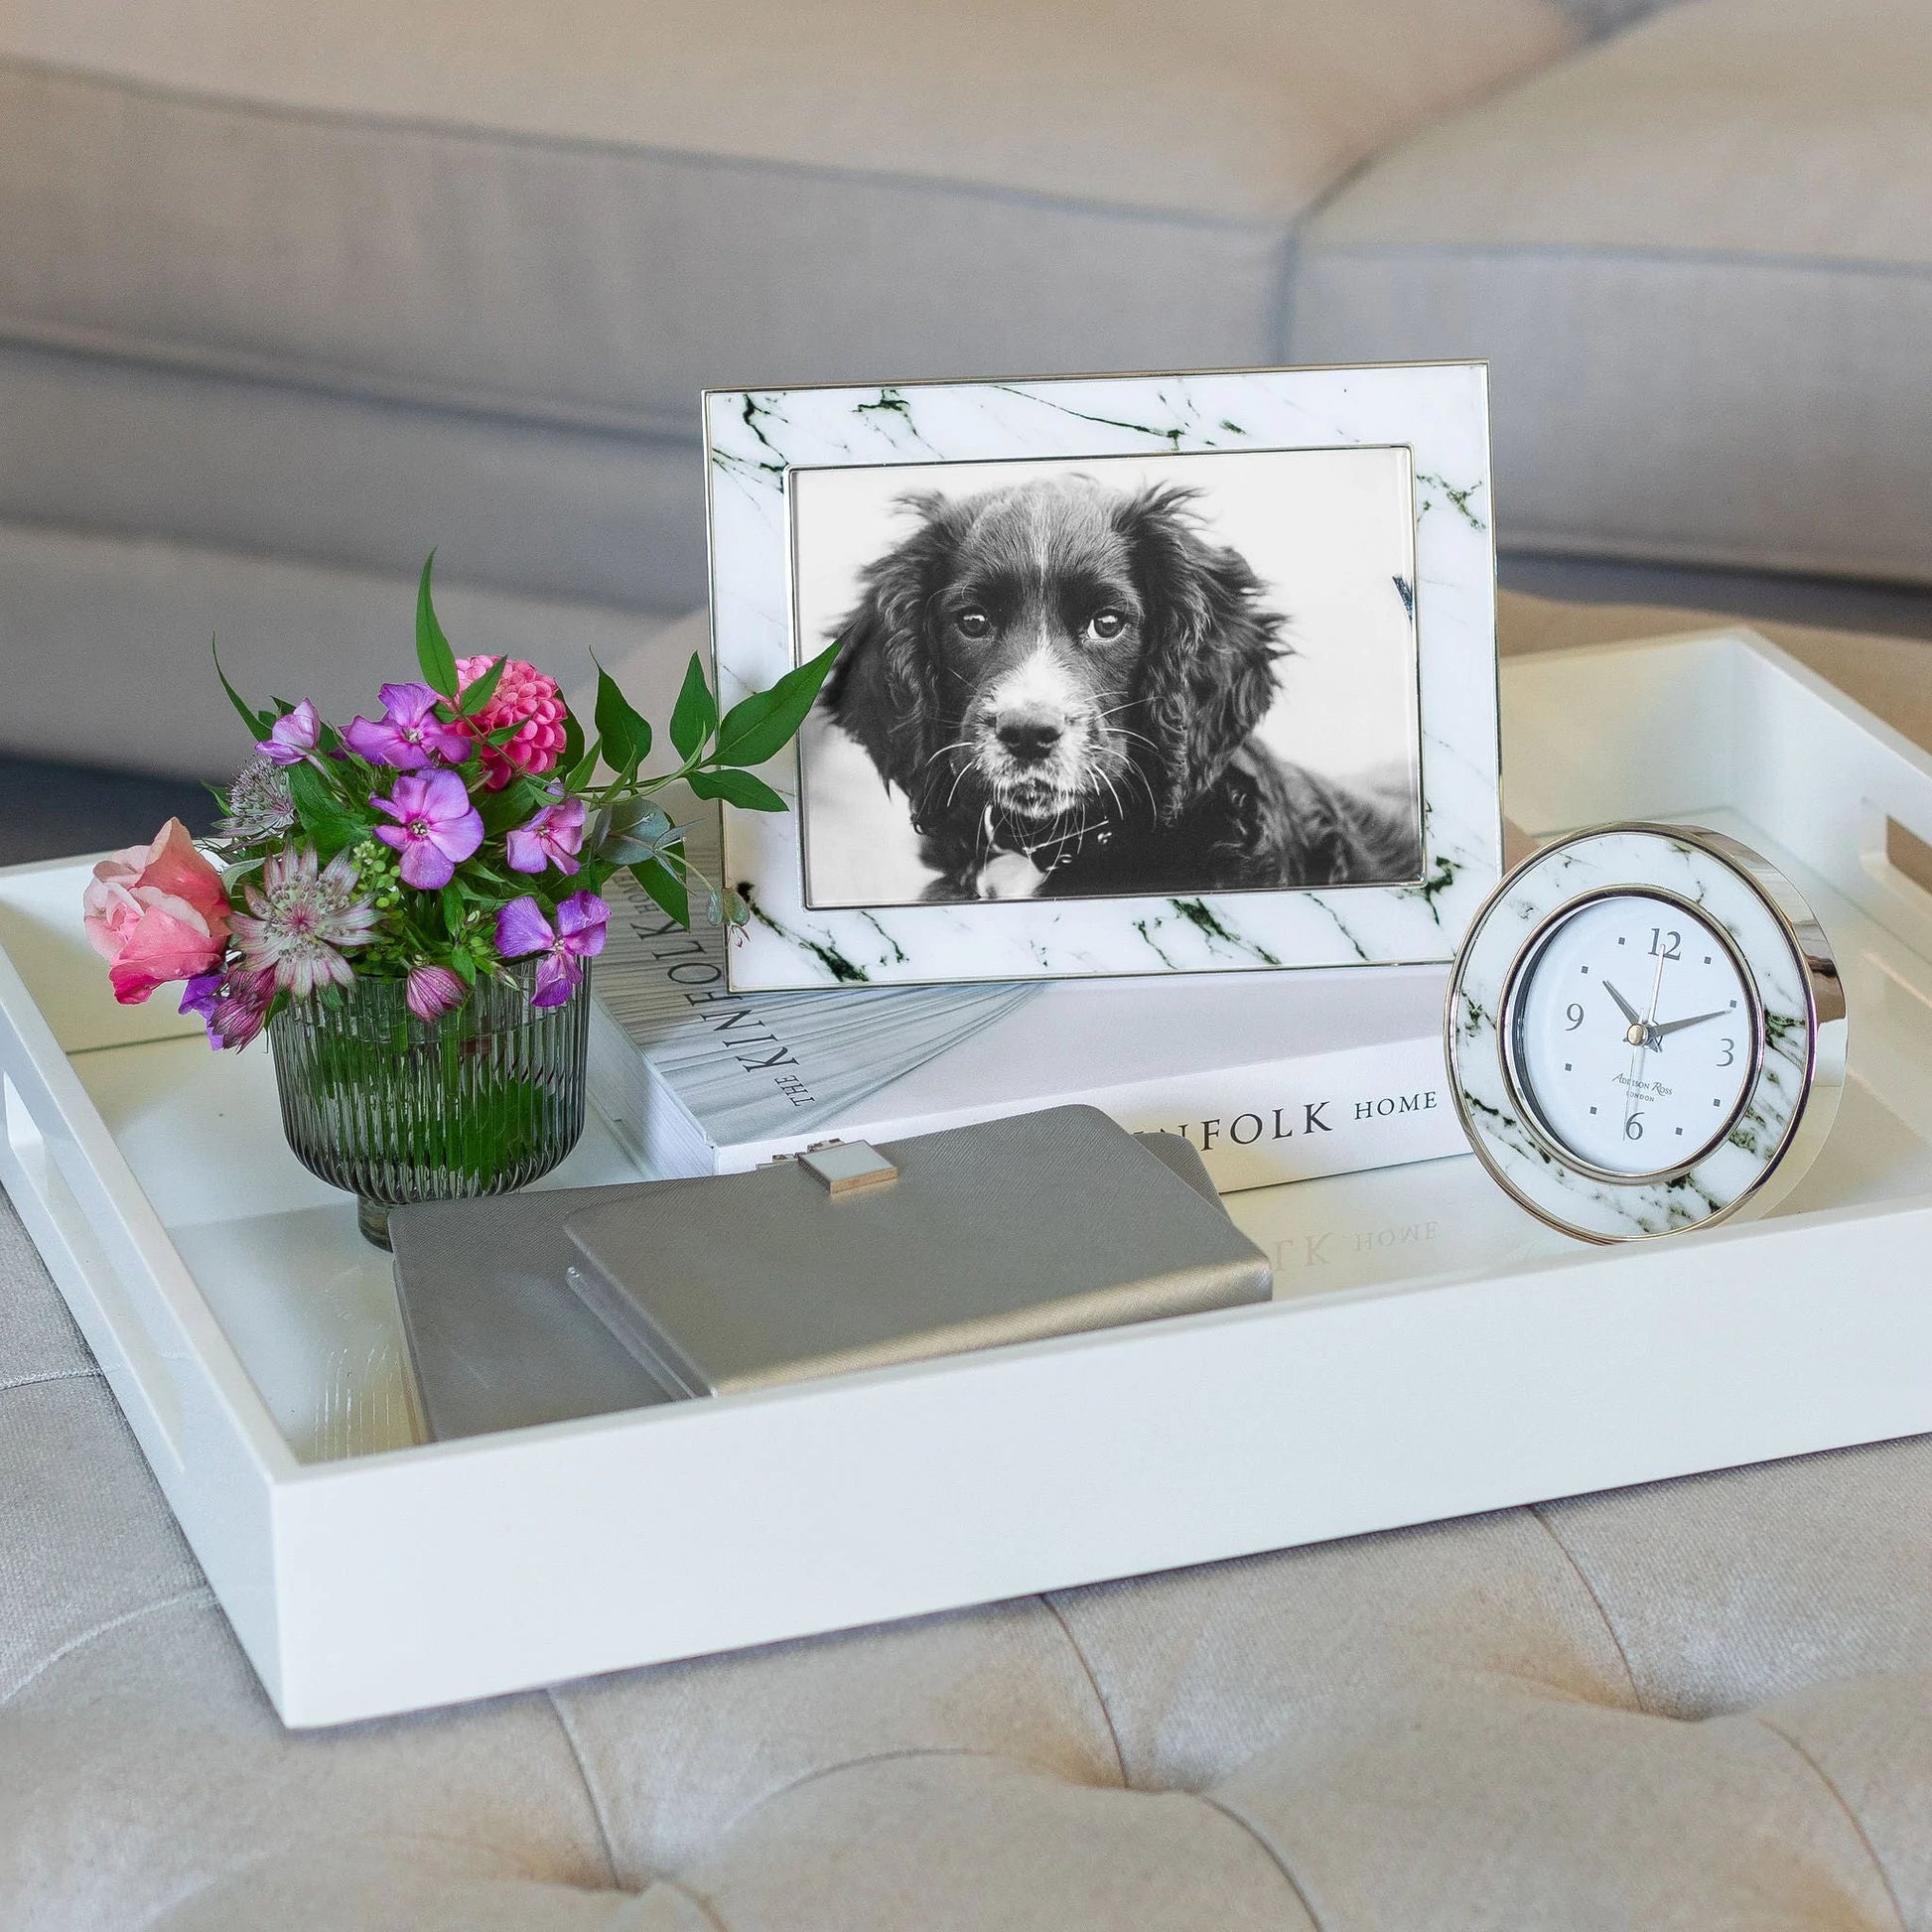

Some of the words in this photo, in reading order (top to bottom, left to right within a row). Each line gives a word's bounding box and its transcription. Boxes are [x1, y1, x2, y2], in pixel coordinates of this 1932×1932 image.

[1647, 927, 1682, 961] 12
[629, 919, 800, 1072] KINFOLK
[1565, 1003, 1585, 1032] 9
[1716, 1037, 1735, 1067] 3
[773, 1074, 815, 1107] THE
[1133, 1100, 1333, 1152] FOLK
[1353, 1090, 1439, 1121] HOME
[1625, 1112, 1645, 1141] 6
